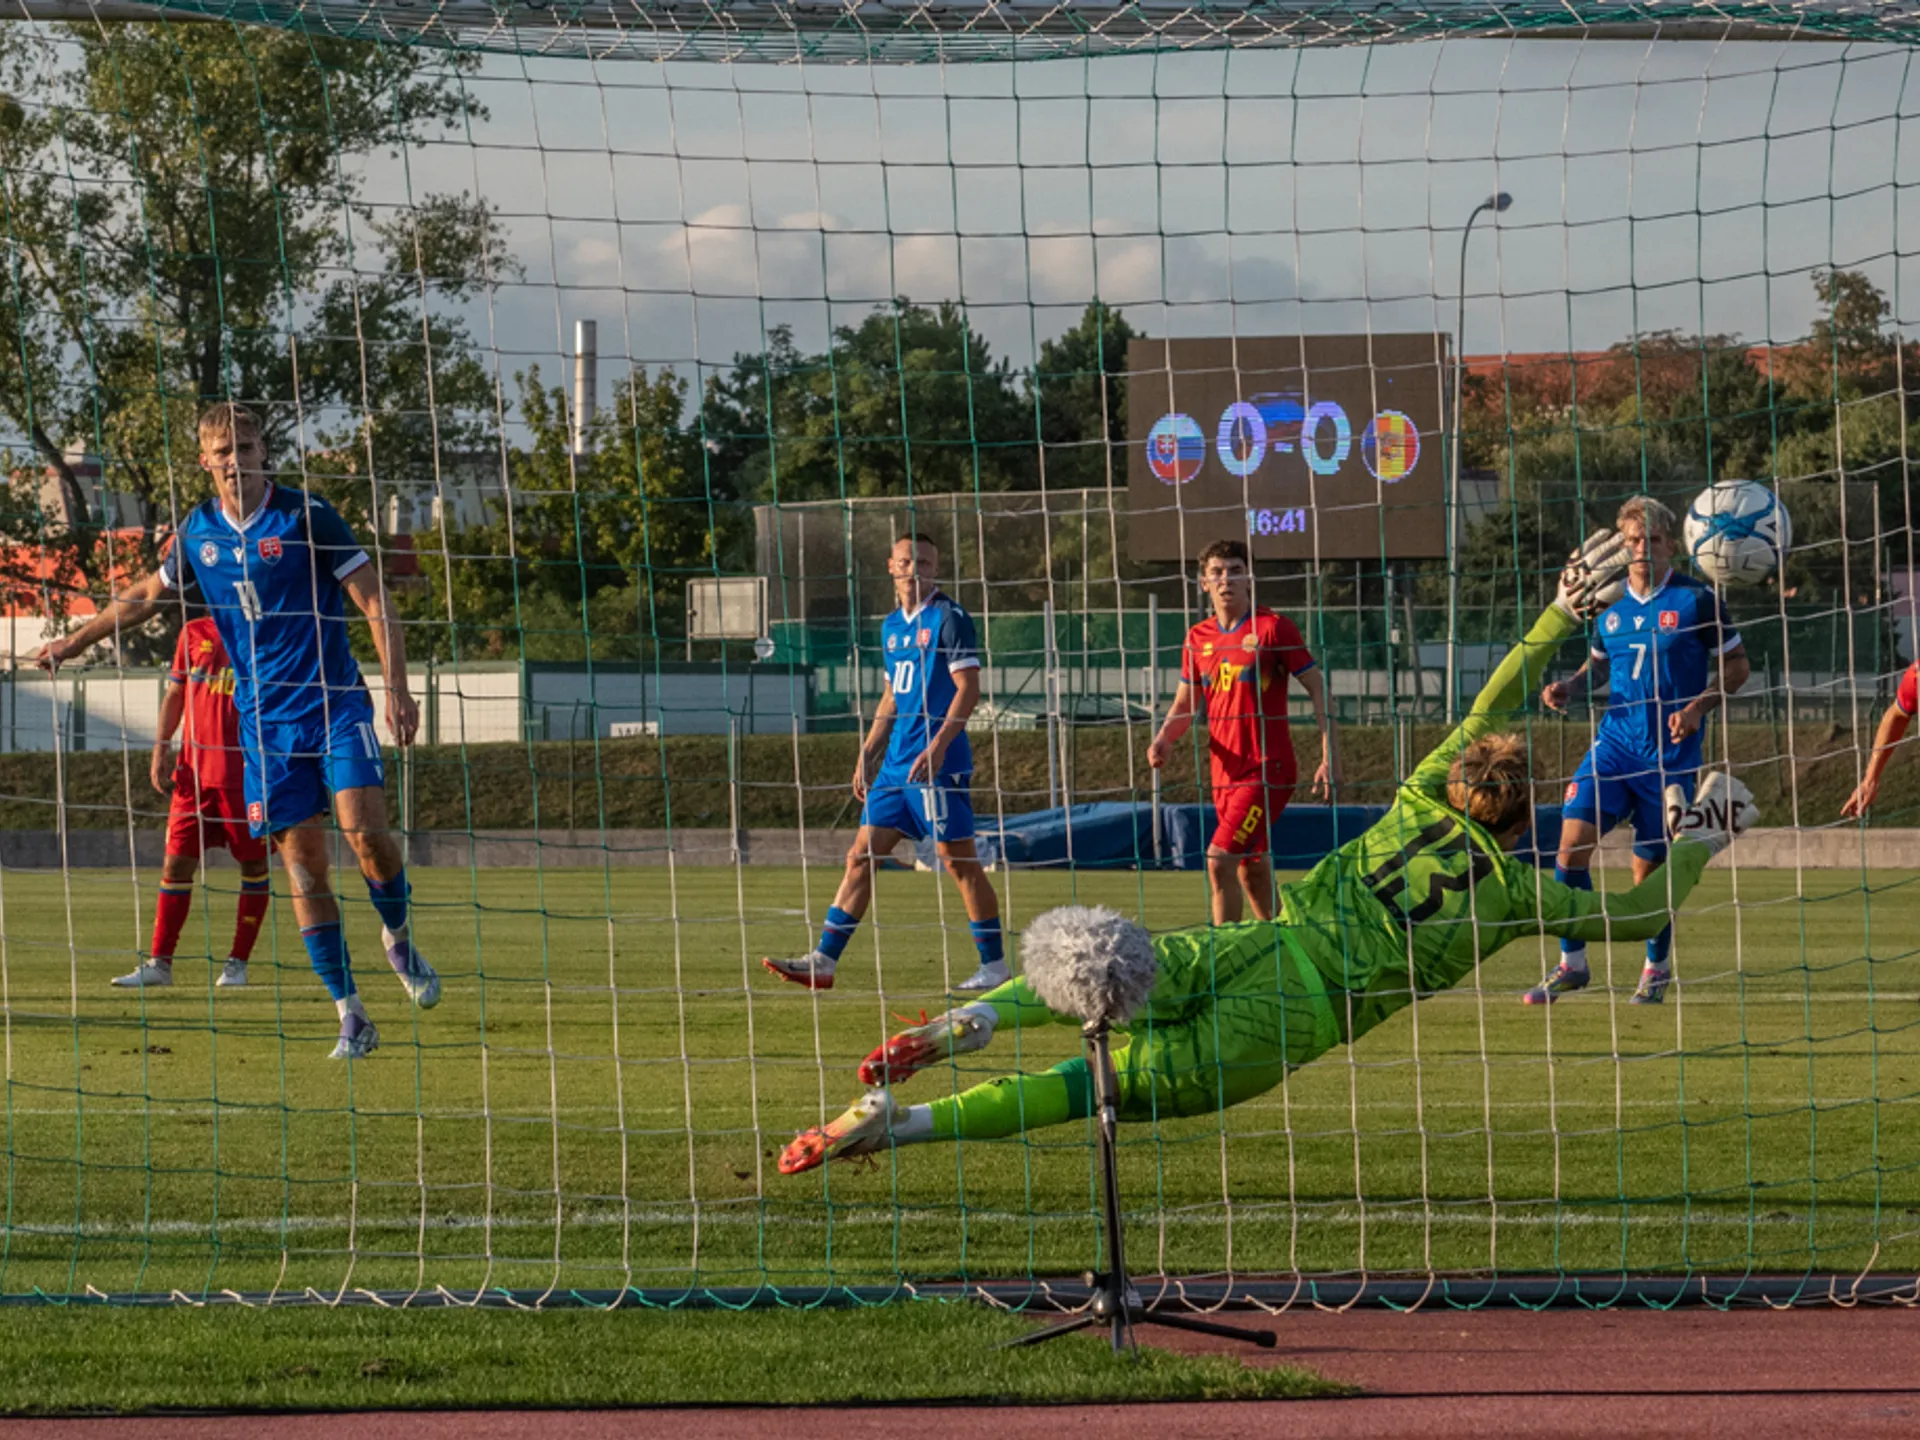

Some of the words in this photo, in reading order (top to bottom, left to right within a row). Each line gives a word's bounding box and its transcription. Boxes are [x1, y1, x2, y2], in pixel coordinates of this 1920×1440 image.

[1247, 508, 1306, 536] 16:41
[892, 660, 915, 694] 10
[1628, 643, 1647, 680] 7
[920, 786, 949, 822] 10
